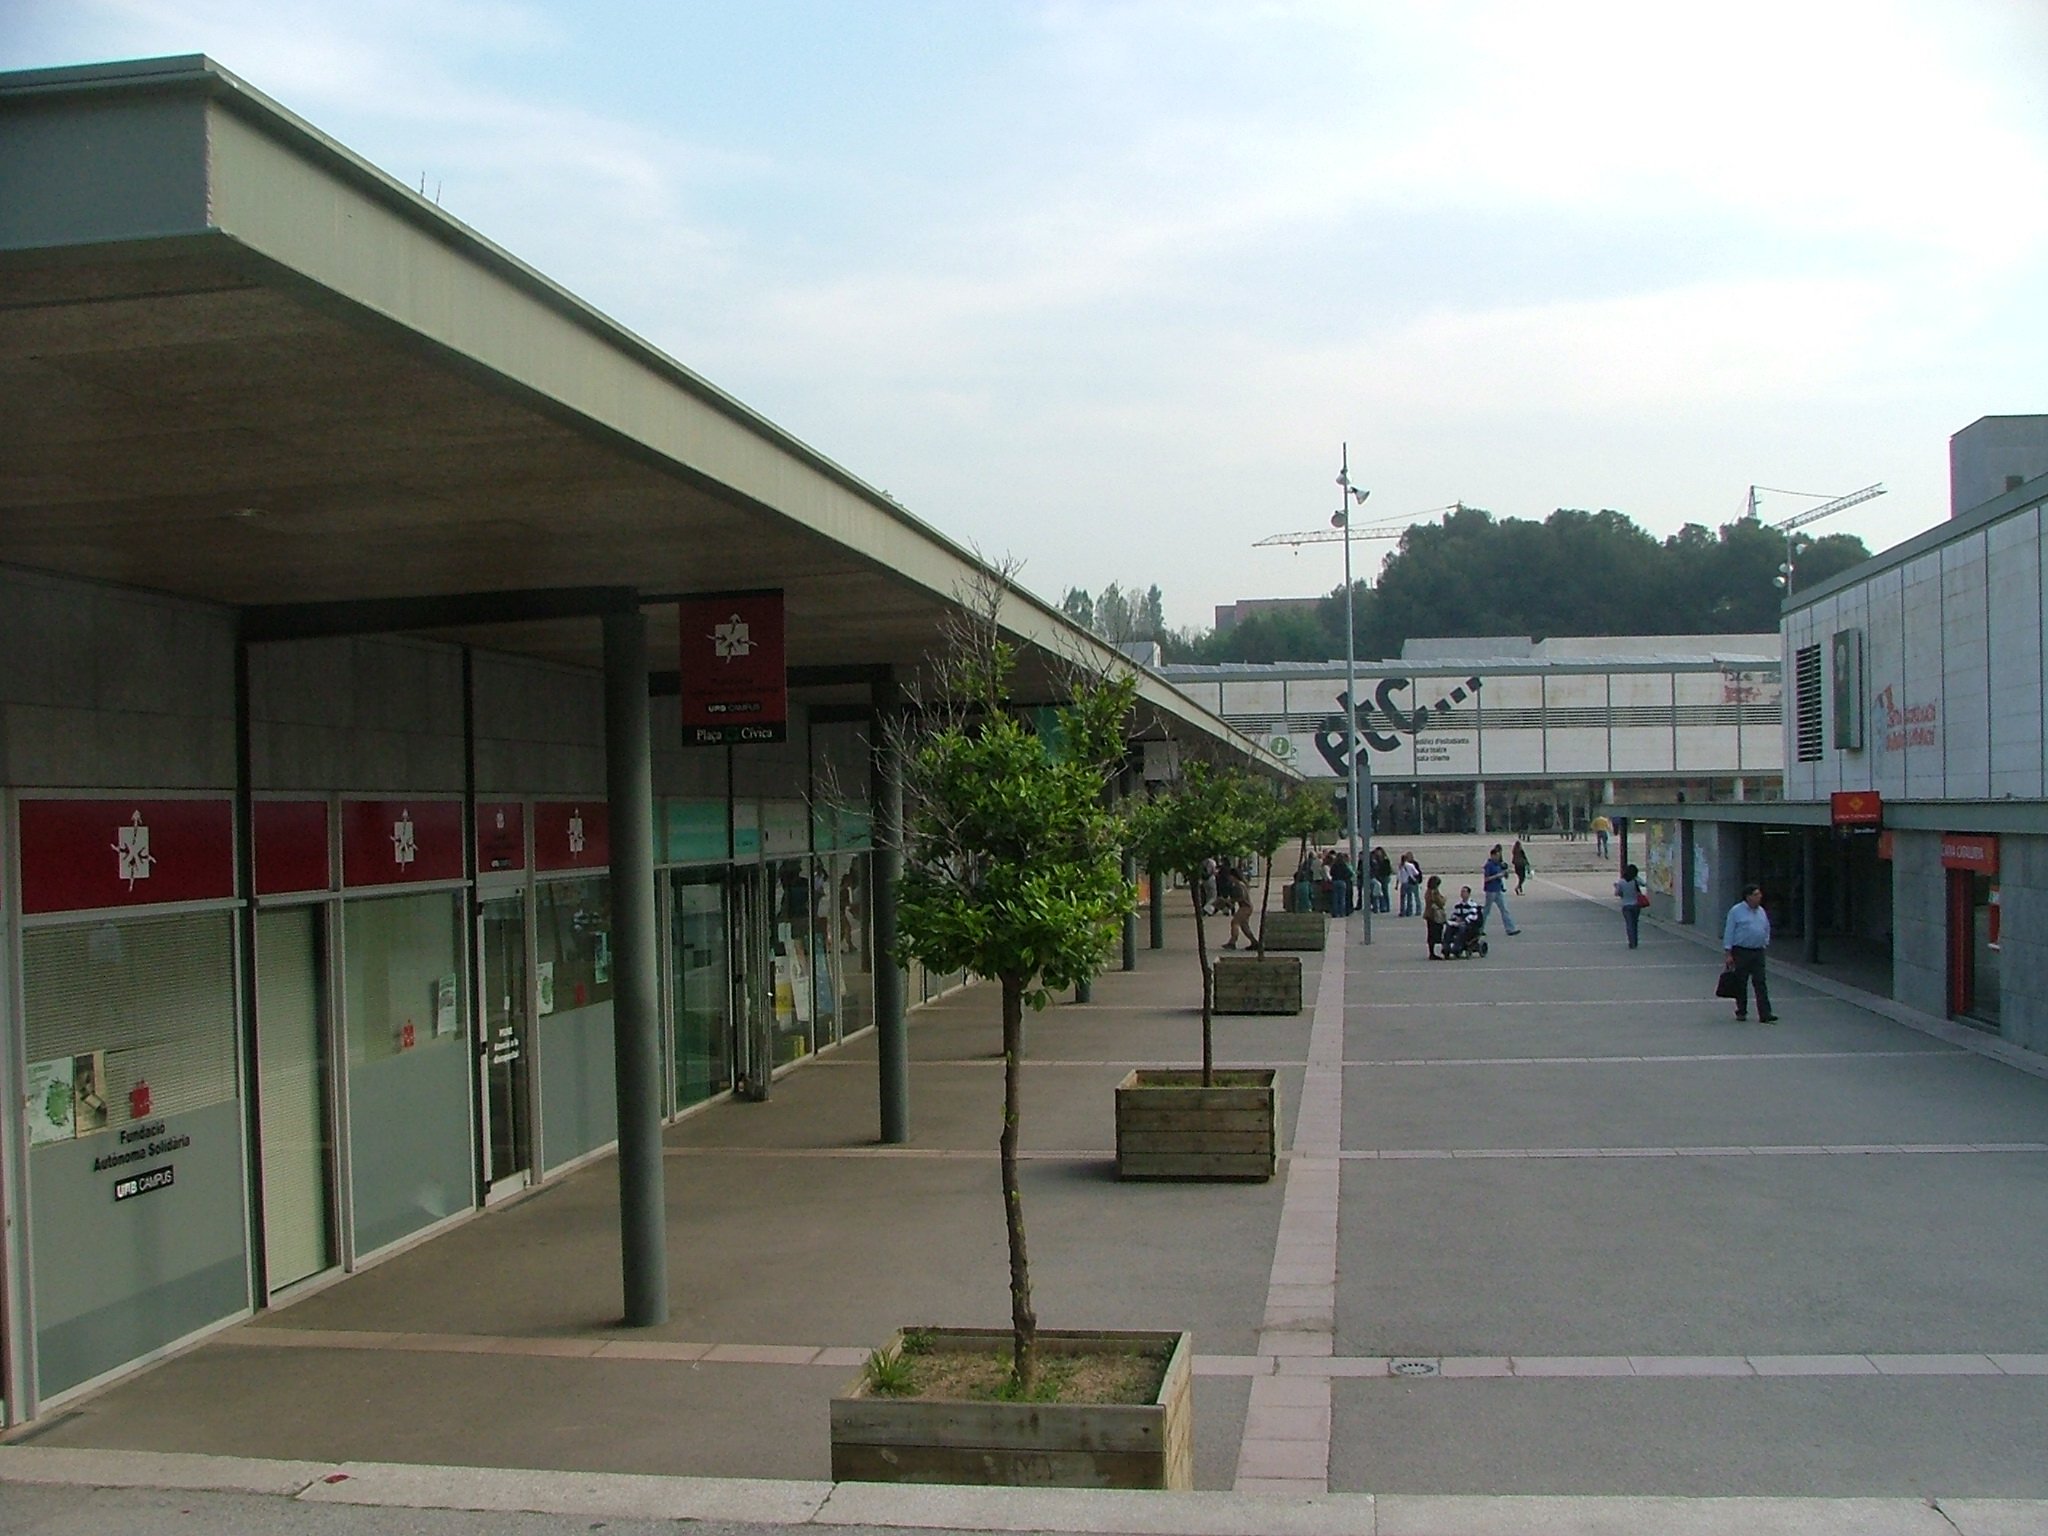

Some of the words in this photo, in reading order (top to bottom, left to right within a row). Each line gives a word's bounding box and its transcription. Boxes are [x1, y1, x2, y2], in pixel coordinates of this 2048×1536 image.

[696, 727, 722, 743] Plaça
[120, 1122, 166, 1145] Fundació
[94, 1150, 147, 1173] Autònoma
[148, 1133, 191, 1157] Solidària
[138, 1169, 173, 1192] CAMPUS
